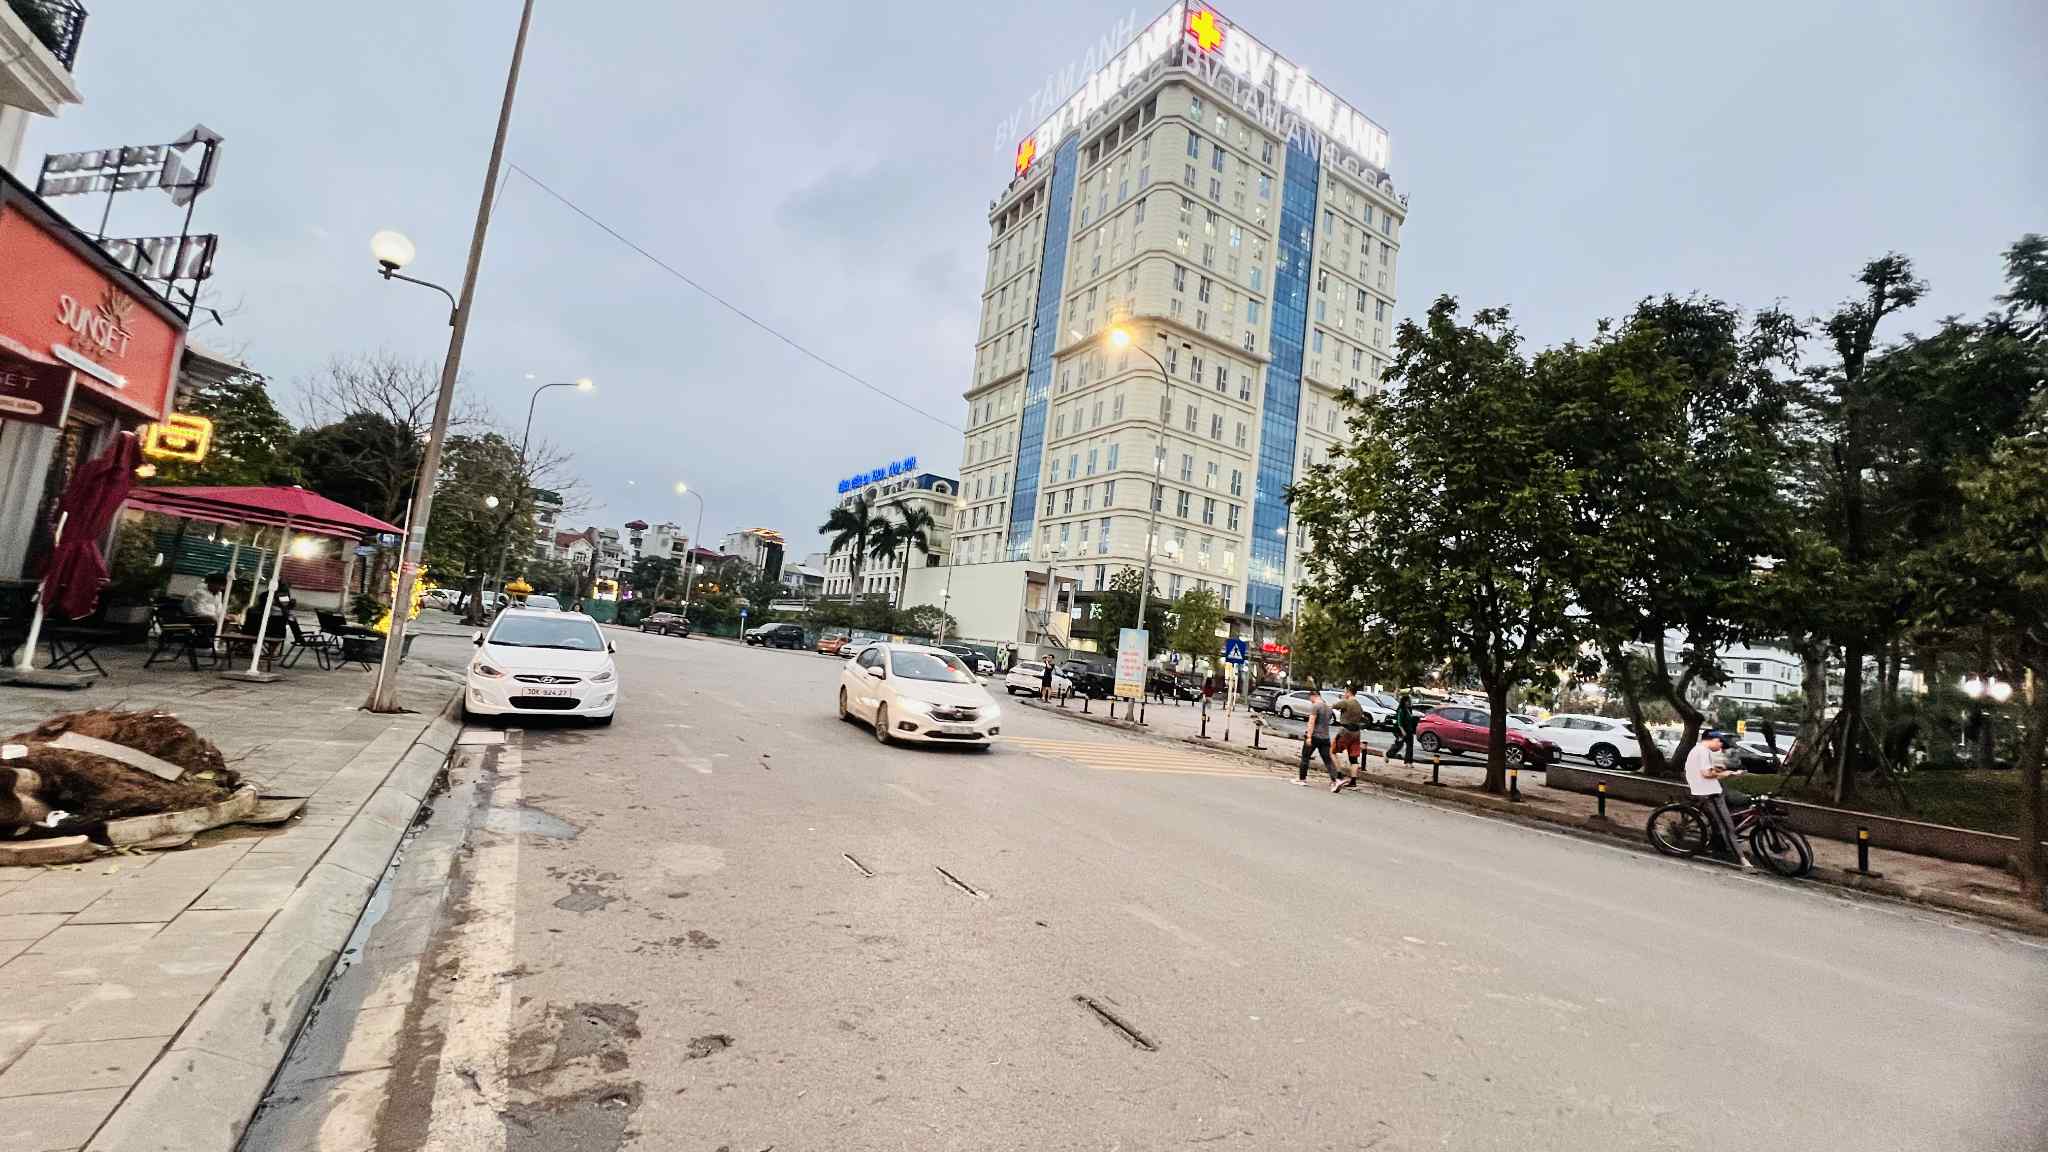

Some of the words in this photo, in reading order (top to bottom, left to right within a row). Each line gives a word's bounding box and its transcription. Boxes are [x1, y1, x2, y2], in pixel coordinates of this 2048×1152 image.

[1119, 2, 1185, 88] ANH
[1225, 26, 1273, 86] BV
[1334, 104, 1391, 170] ANH
[57, 294, 131, 358] SUNSET
[0, 372, 38, 389] ET
